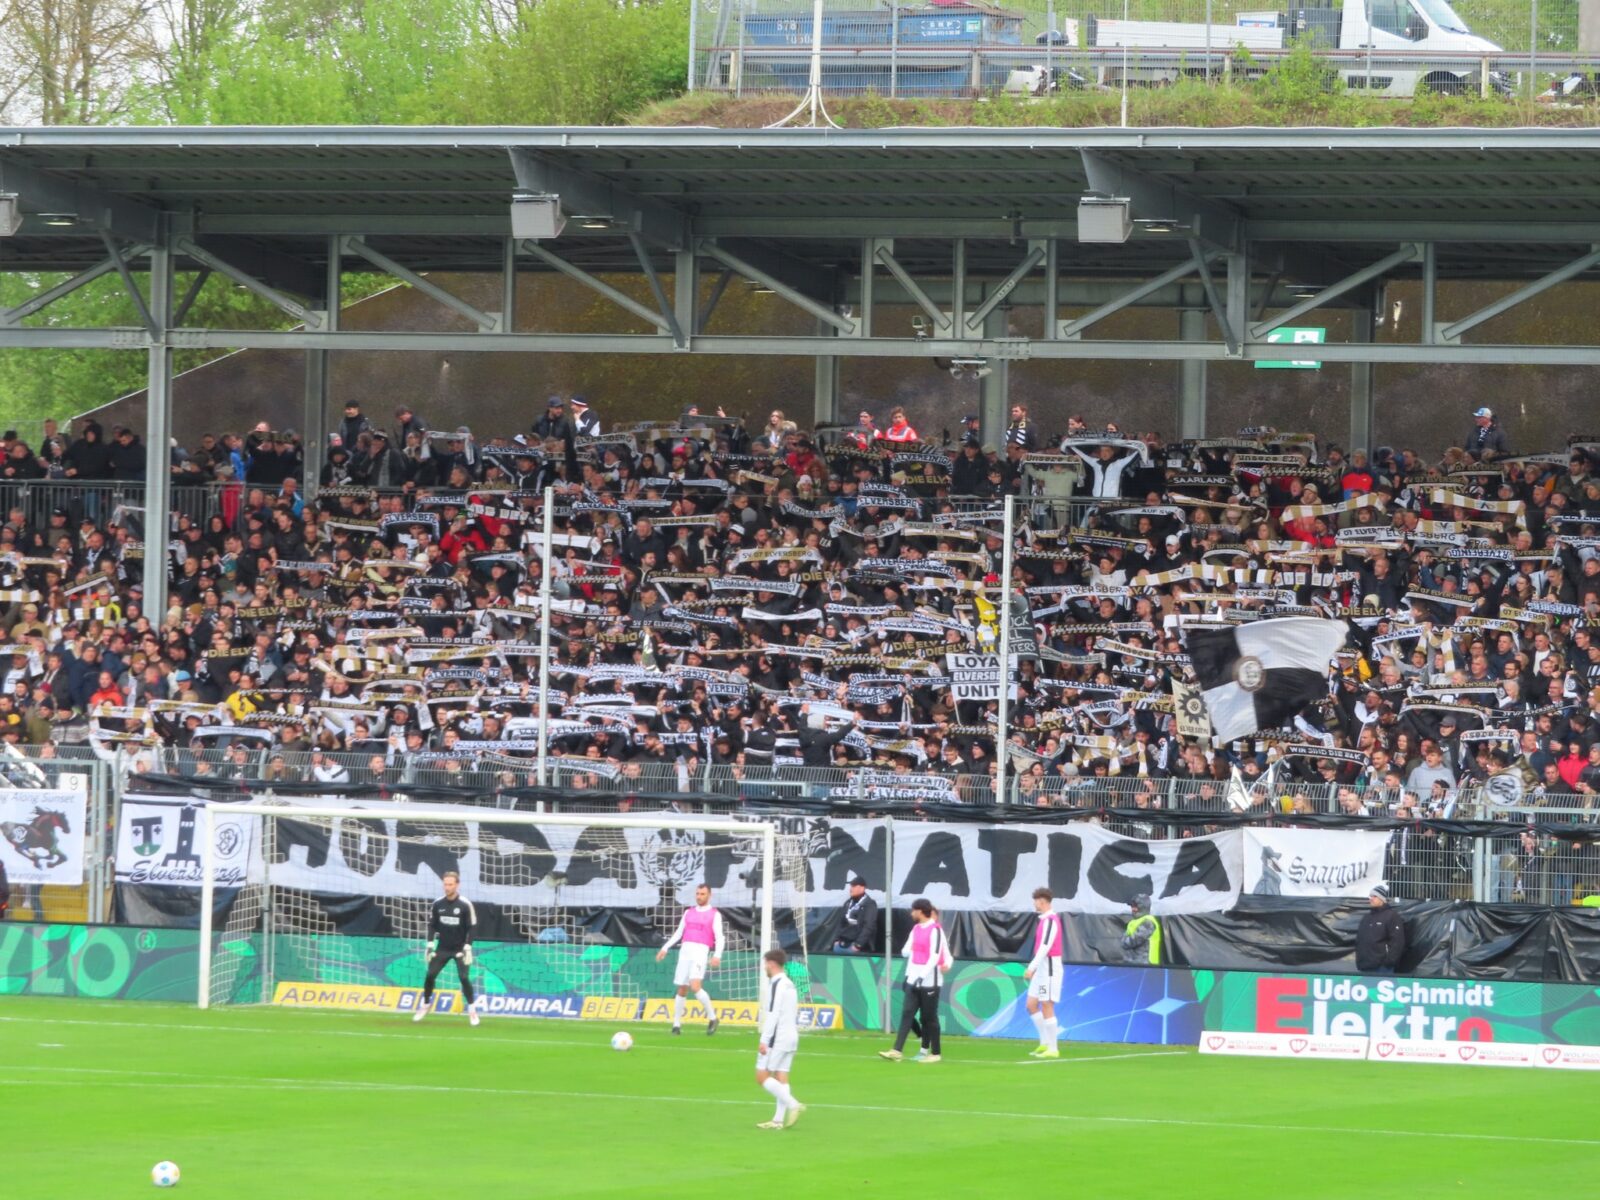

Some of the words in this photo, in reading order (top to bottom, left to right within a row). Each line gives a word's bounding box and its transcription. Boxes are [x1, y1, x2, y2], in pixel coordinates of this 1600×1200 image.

[803, 572, 822, 581] DIE
[1431, 590, 1473, 601] ELVERSBERG
[239, 608, 257, 618] DIE
[258, 607, 279, 617] ELV
[1341, 607, 1360, 616] DIE
[893, 642, 914, 650] DIE
[926, 646, 945, 656] DIE
[946, 642, 966, 653] ELV
[208, 649, 229, 658] DIE
[230, 647, 251, 657] ELV
[954, 656, 1010, 668] LOYA
[953, 671, 1014, 680] ELVERSBEG
[1450, 680, 1498, 689] ELVERSBERG
[1328, 749, 1343, 757] DIE
[130, 860, 242, 885] Elverserg
[280, 987, 392, 1008] ADMIRAL
[1313, 978, 1368, 1002] Udo
[1377, 980, 1494, 1007] Schmidt
[473, 994, 578, 1015] ADMIRAL
[586, 1001, 634, 1014] BET
[1255, 977, 1494, 1043] Elektro
